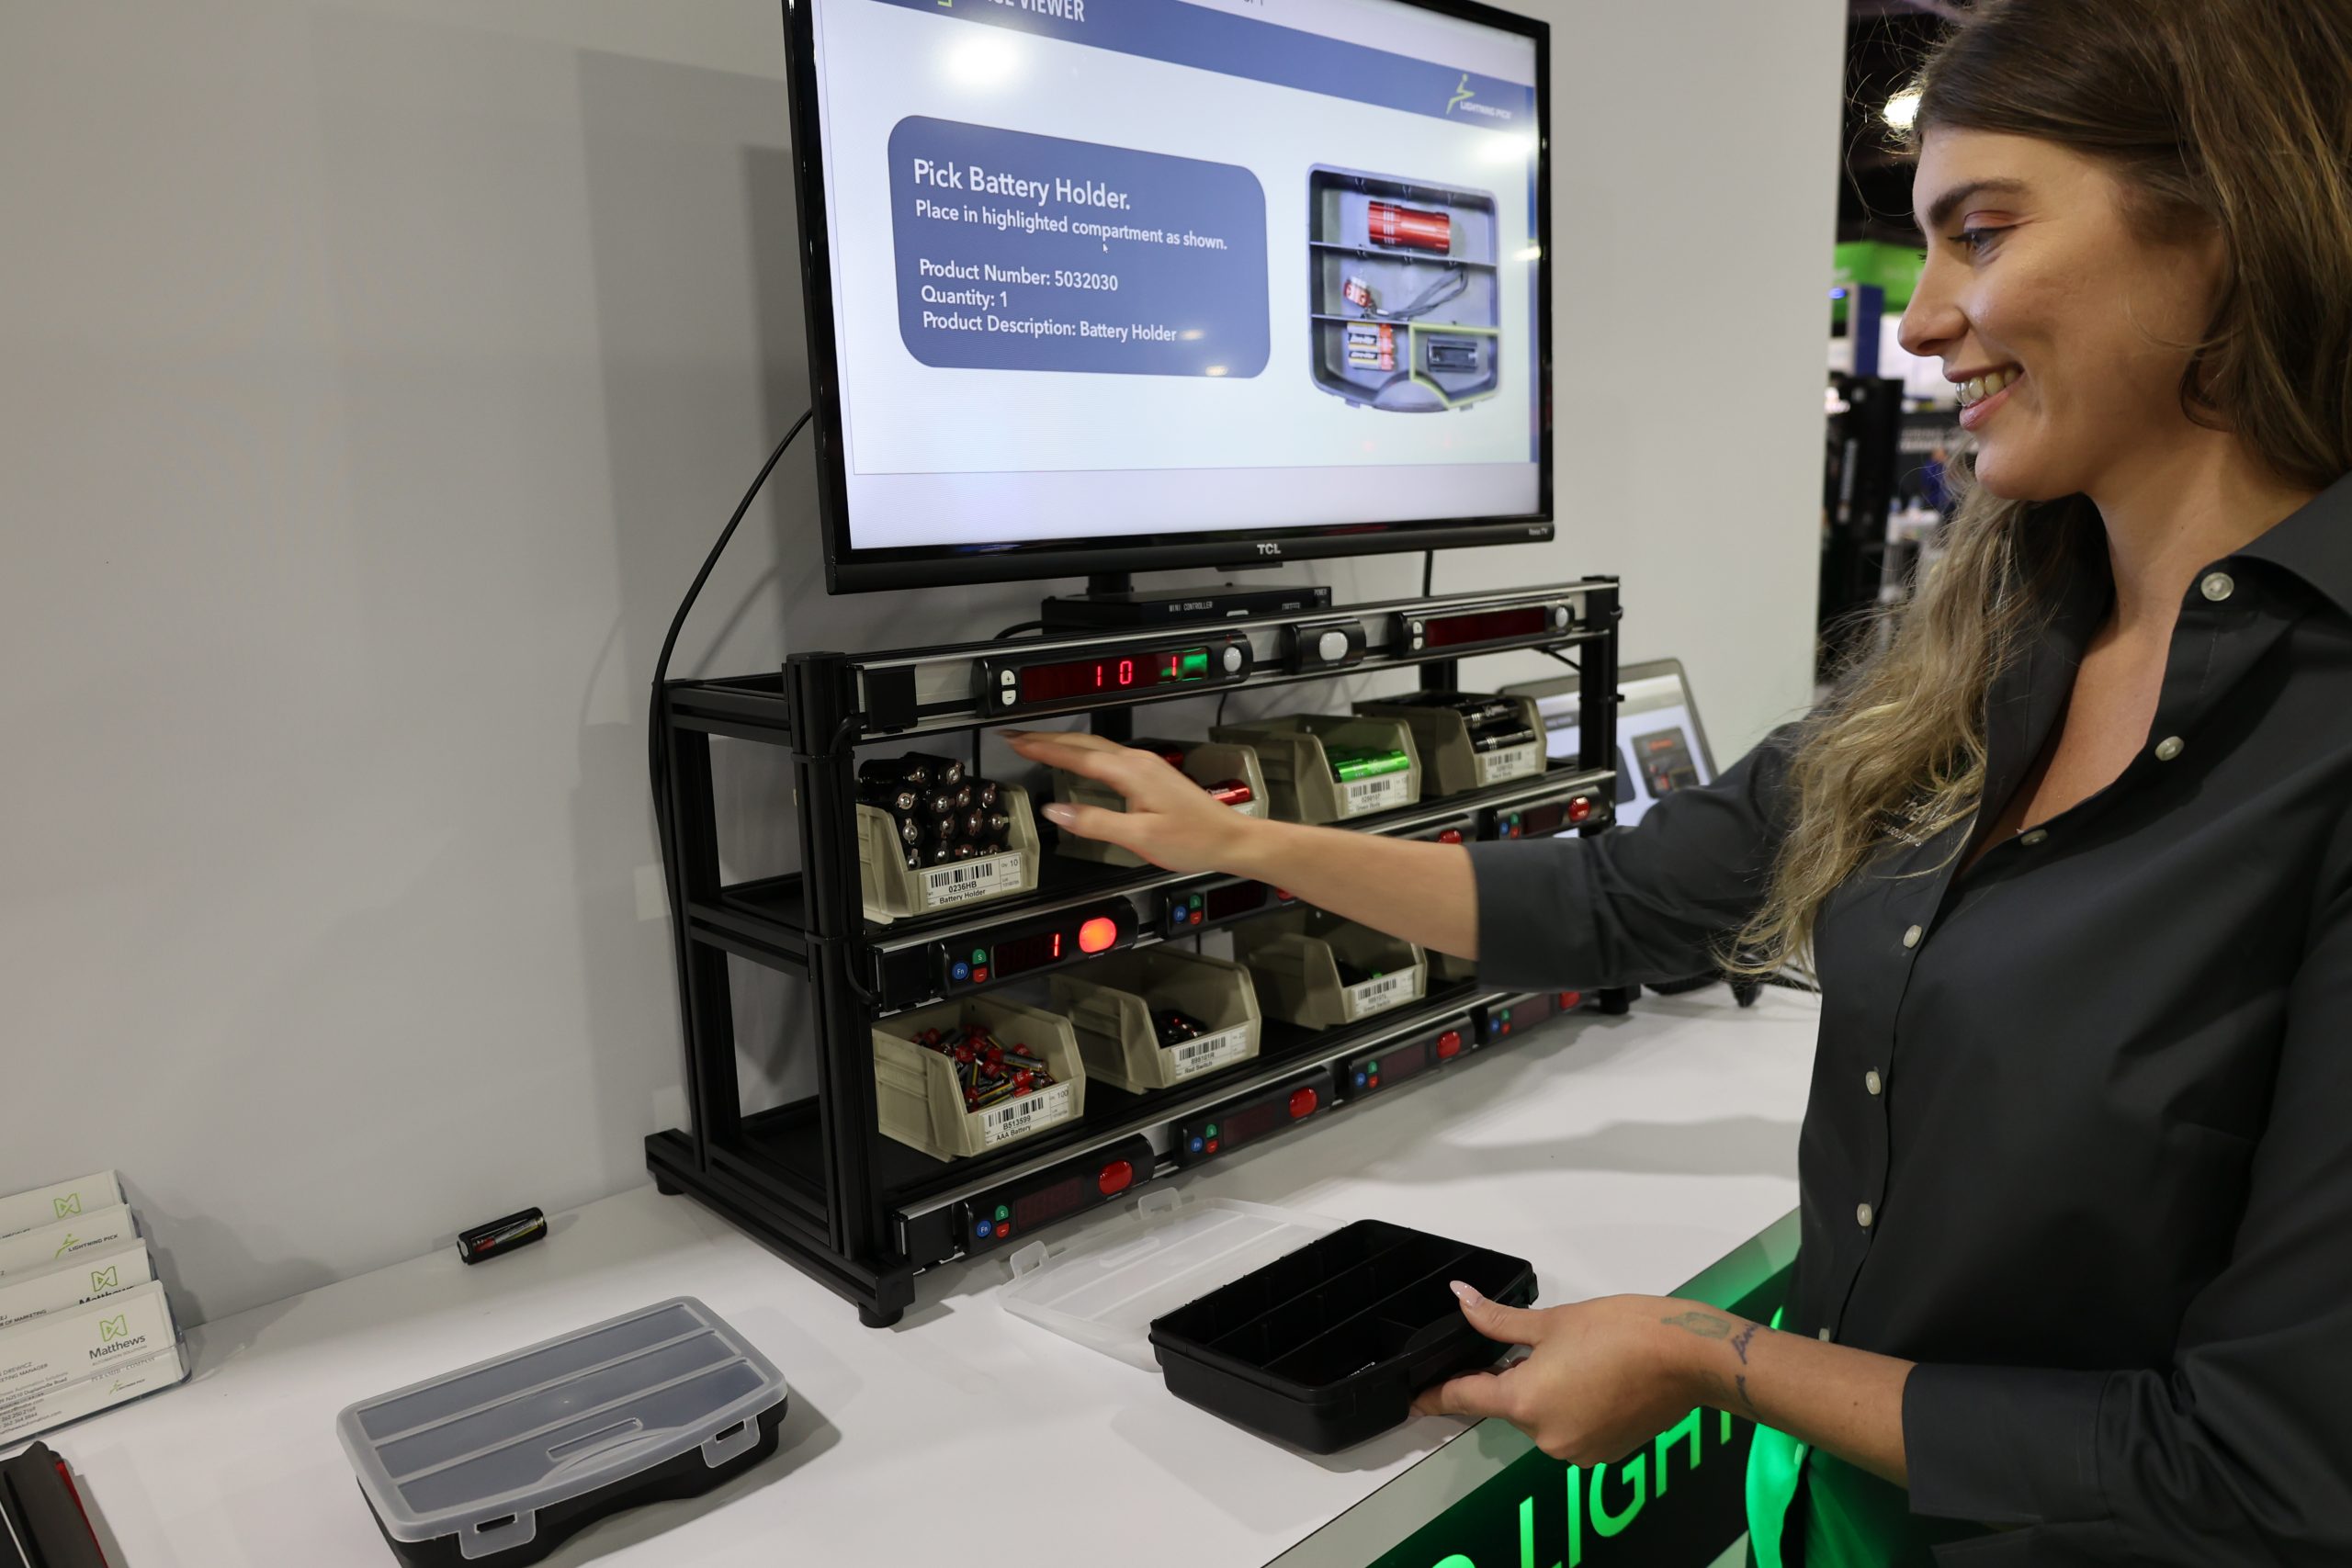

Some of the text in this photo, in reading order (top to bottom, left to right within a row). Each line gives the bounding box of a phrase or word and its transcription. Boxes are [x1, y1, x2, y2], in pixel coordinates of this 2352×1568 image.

[914, 158, 1131, 210] Pick Battery Holder.
[916, 199, 1228, 250] Place in highlighted compartment as shown.
[919, 258, 1118, 291] Product Number: 5032030
[921, 285, 1008, 311] Quantity: 1
[922, 310, 1177, 343] Product Description: Battery Holder
[1257, 543, 1281, 555] TCL
[1169, 601, 1214, 613] MINI CONTROLLER
[1010, 859, 1018, 867] 10
[948, 881, 977, 893] 0236HB
[939, 893, 963, 905] Battery
[964, 889, 986, 899] Holder
[1054, 933, 1059, 956] 1
[1196, 1061, 1213, 1070] Switch
[1057, 1089, 1069, 1100] 100
[1002, 1115, 1031, 1131] B513599
[997, 1132, 1009, 1141] AAA
[1011, 1125, 1031, 1137] Battery
[68, 1234, 119, 1252] LIGHTNING PICK
[14, 1309, 47, 1323] MARKETING
[89, 1335, 146, 1359] Matthews
[19, 1363, 48, 1376] MANAGER
